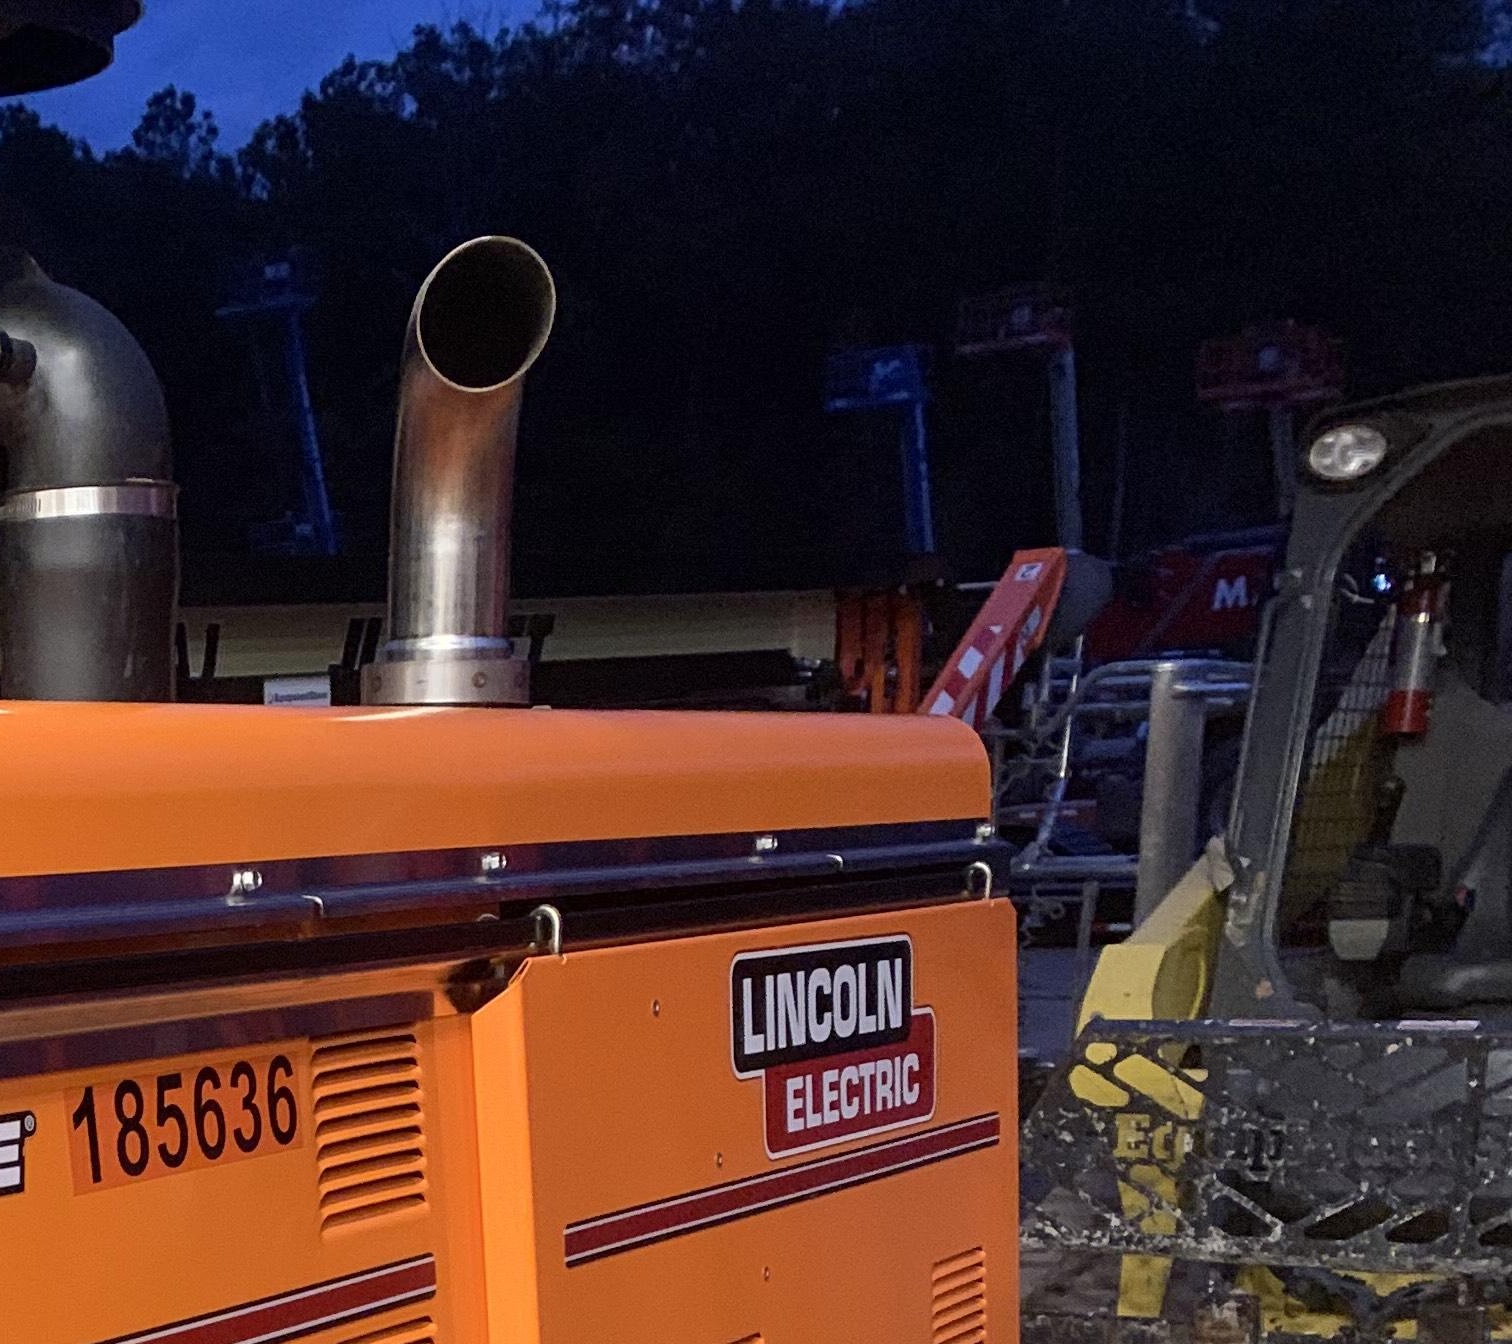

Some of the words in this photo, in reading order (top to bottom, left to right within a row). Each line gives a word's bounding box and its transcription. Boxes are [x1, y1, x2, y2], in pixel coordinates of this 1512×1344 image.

[742, 957, 903, 1055] LINCOLN
[72, 1053, 300, 1186] 185636
[786, 1053, 920, 1133] ELECTRIC
